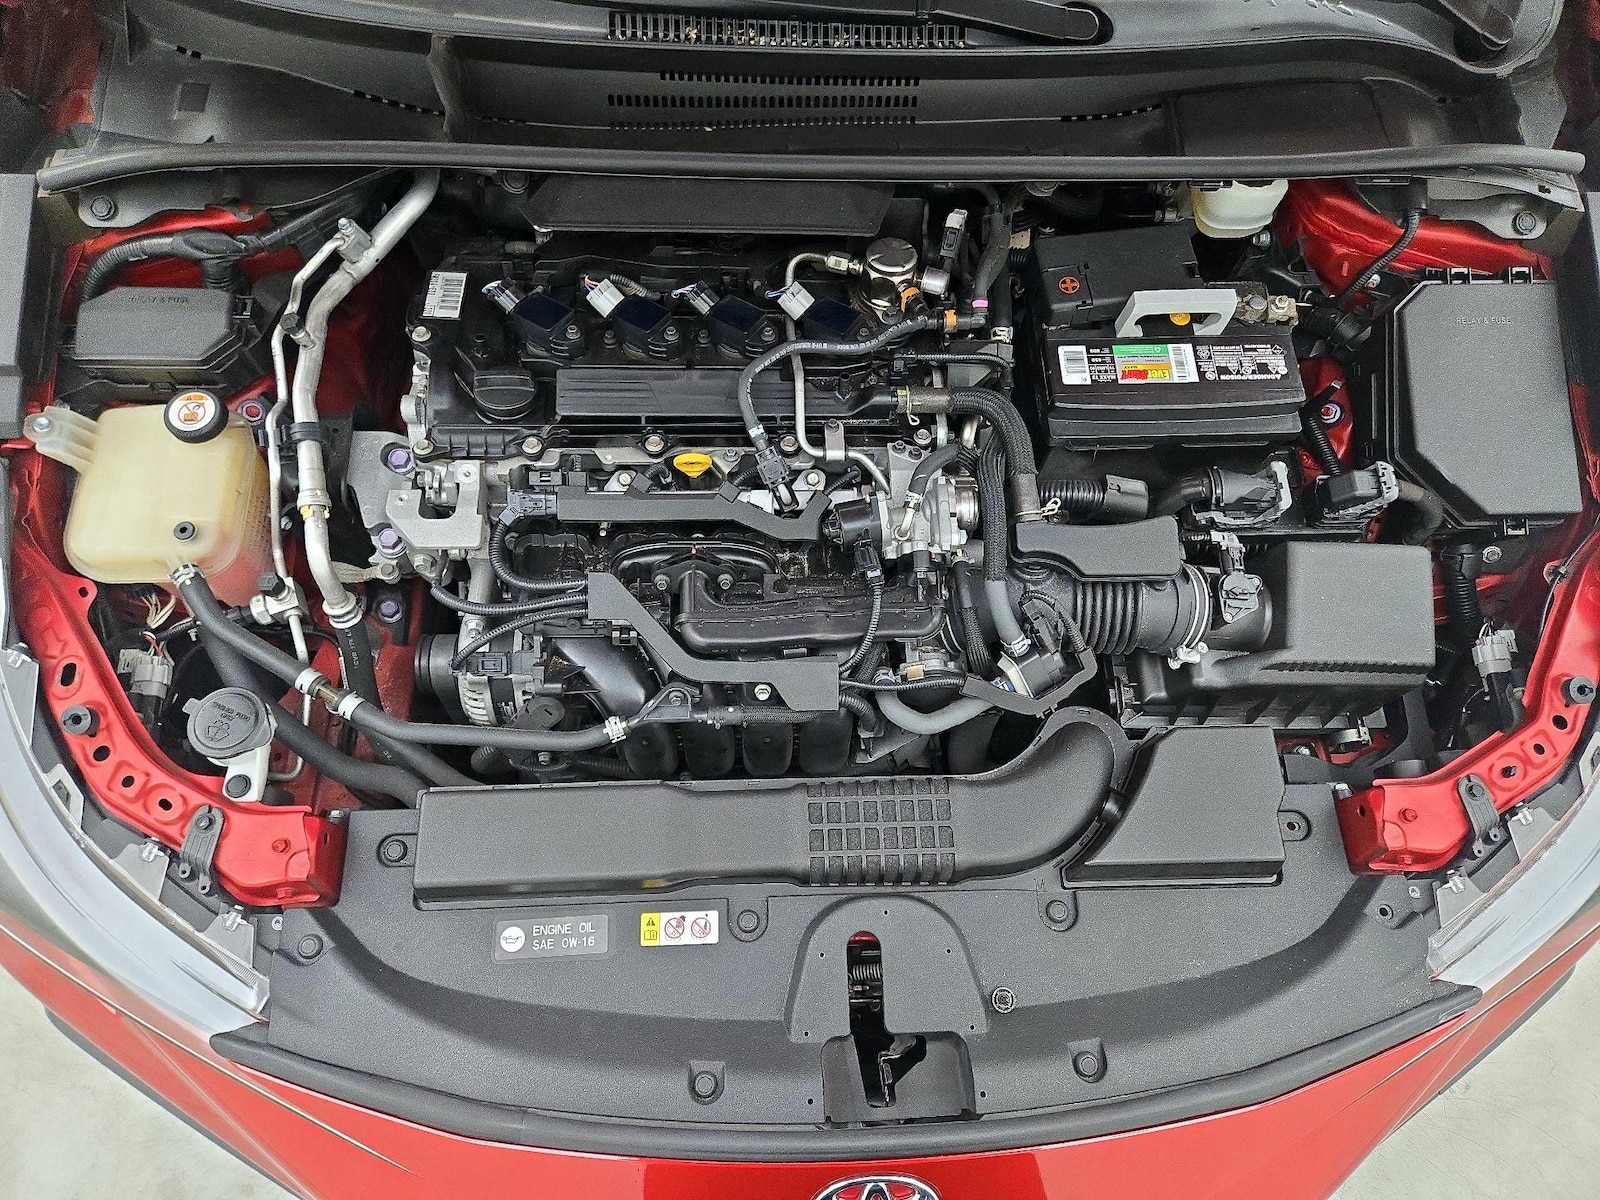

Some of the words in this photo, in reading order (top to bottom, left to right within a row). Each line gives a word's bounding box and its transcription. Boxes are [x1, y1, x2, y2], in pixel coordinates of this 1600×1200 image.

[1456, 316, 1481, 325] RELAY
[1491, 316, 1512, 325] FUSE
[1120, 369, 1170, 381] EverStart
[532, 923, 572, 937] ENGINE
[579, 922, 596, 933] OIL
[532, 938, 554, 951] SAE
[561, 936, 595, 949] 0W-16
